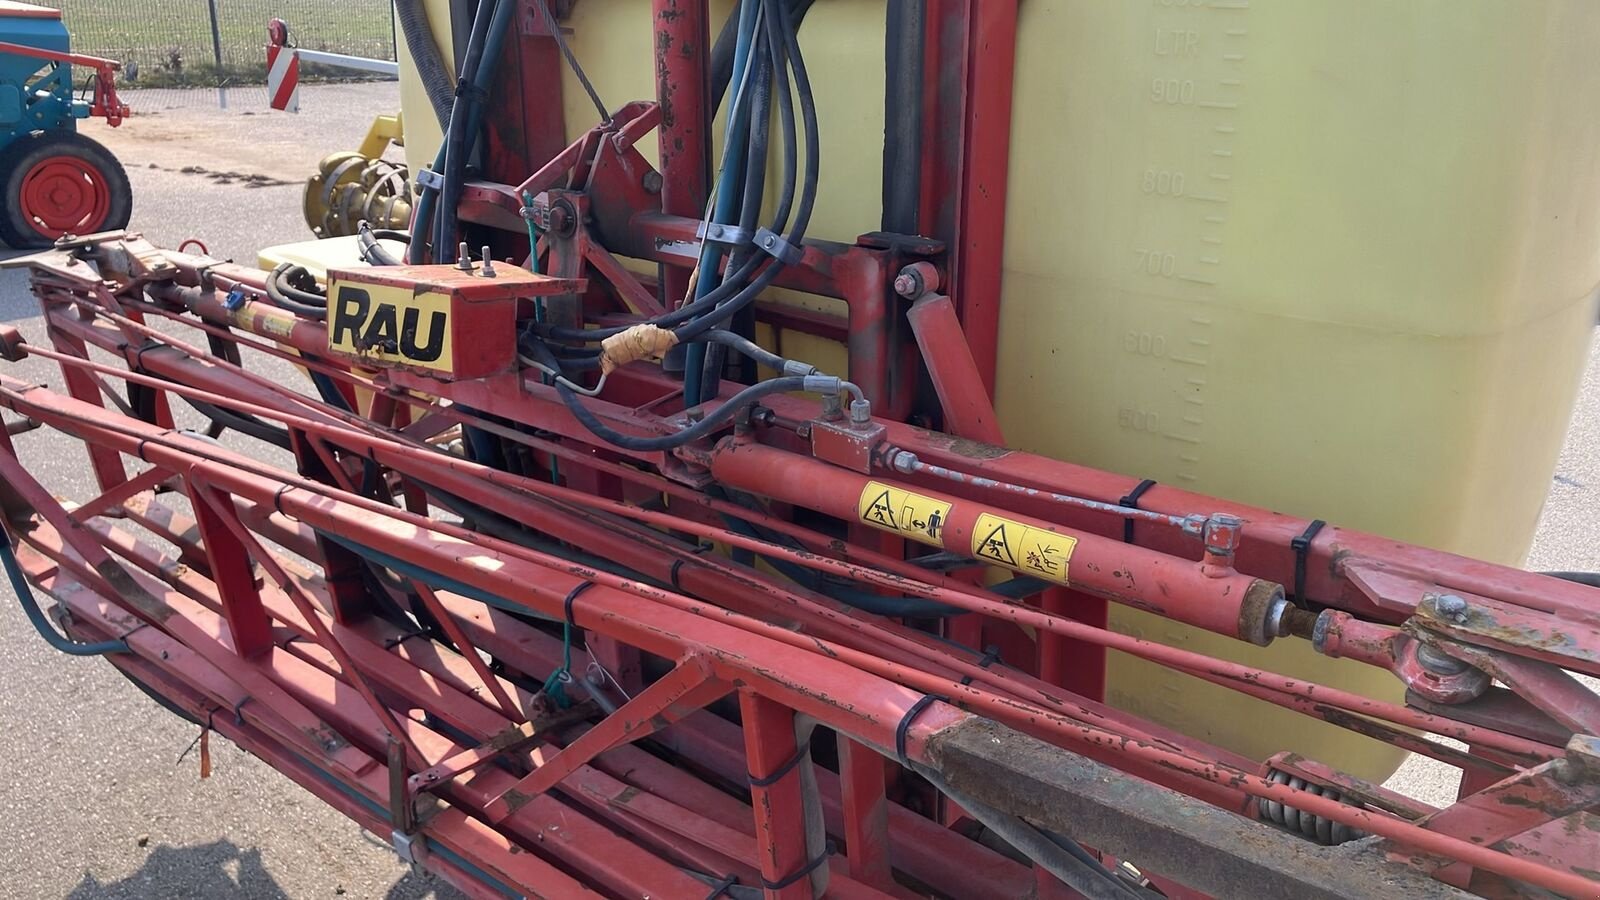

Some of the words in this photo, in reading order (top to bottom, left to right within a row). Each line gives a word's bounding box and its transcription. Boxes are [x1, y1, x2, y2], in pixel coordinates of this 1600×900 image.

[1154, 28, 1200, 56] LTR
[1151, 78, 1195, 105] 900
[1142, 169, 1185, 197] 800
[1135, 249, 1176, 278] 700
[333, 286, 447, 362] RAU
